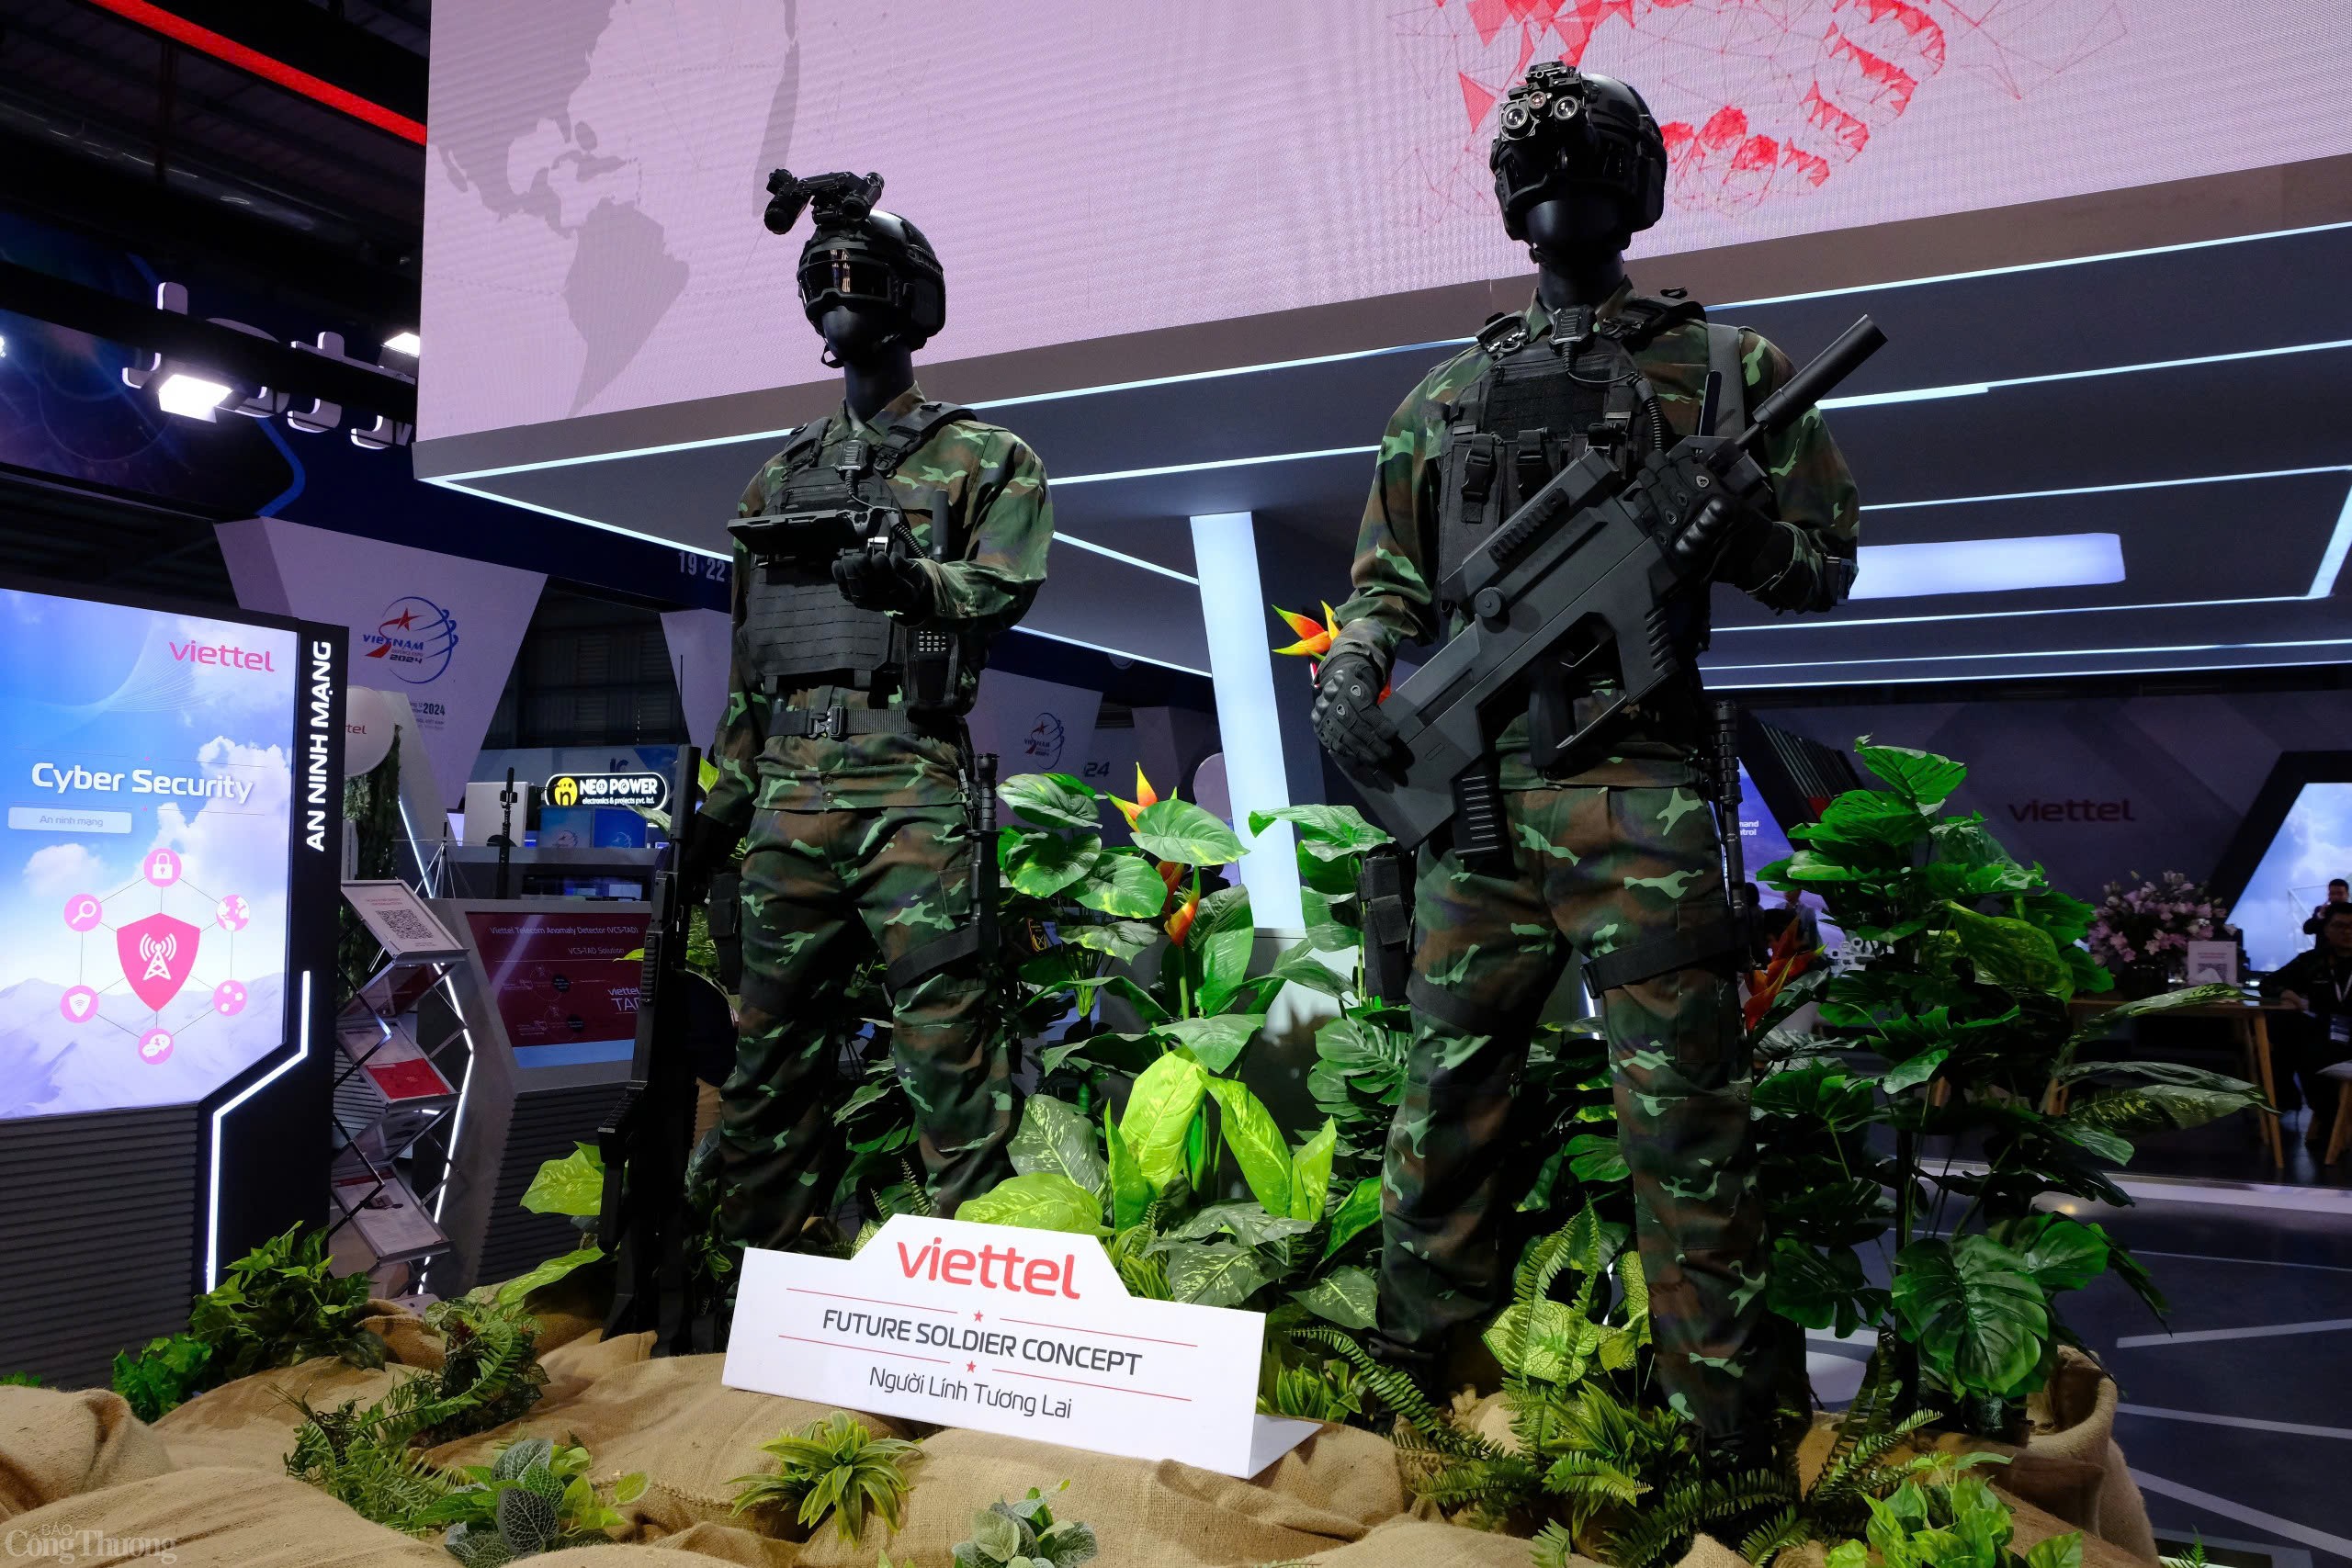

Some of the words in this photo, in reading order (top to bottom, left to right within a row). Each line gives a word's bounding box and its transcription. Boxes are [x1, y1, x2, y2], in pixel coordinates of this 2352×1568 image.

[706, 557, 726, 581] 22
[169, 640, 275, 672] viettel
[311, 640, 333, 728] MẠNG
[423, 703, 445, 716] 2024
[345, 724, 367, 735] tel
[31, 762, 126, 795] Cyber
[130, 769, 254, 805] Security
[308, 734, 329, 805] NINH
[1083, 761, 1110, 778] 24
[579, 778, 608, 795] NEO
[609, 777, 658, 795] POWER
[40, 816, 53, 824] An
[55, 817, 74, 825] ninh
[2007, 799, 2135, 822] viettel
[307, 810, 326, 852] AN
[547, 927, 576, 935] Anomaly
[577, 926, 605, 934] Detector
[897, 1236, 1080, 1300] viettel
[822, 1309, 912, 1342] FUTURE
[915, 1323, 1017, 1358] SOLDIER
[1022, 1337, 1143, 1376] CONCEPT
[869, 1366, 924, 1393] Người
[928, 1373, 968, 1402] Lính
[974, 1383, 1037, 1417] Tương
[1042, 1393, 1072, 1419] Lai
